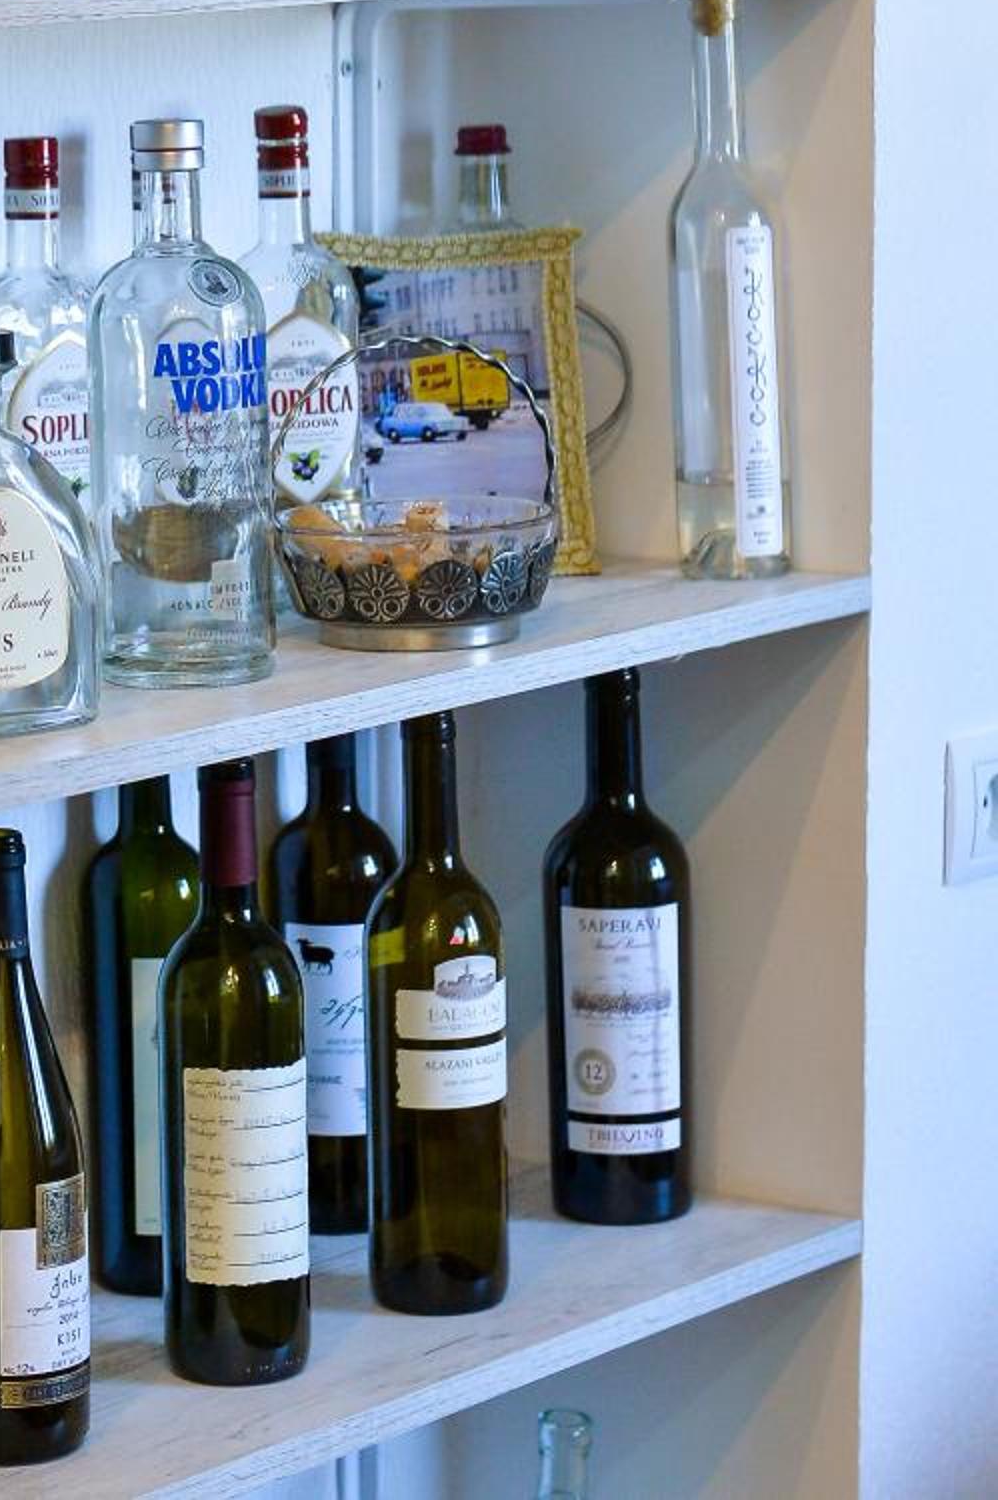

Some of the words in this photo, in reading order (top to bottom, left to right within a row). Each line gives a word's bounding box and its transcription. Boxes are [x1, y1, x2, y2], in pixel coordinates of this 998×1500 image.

[270, 384, 354, 418] OPLICA
[578, 915, 662, 933] SAPERAVI
[585, 1062, 603, 1081] 12
